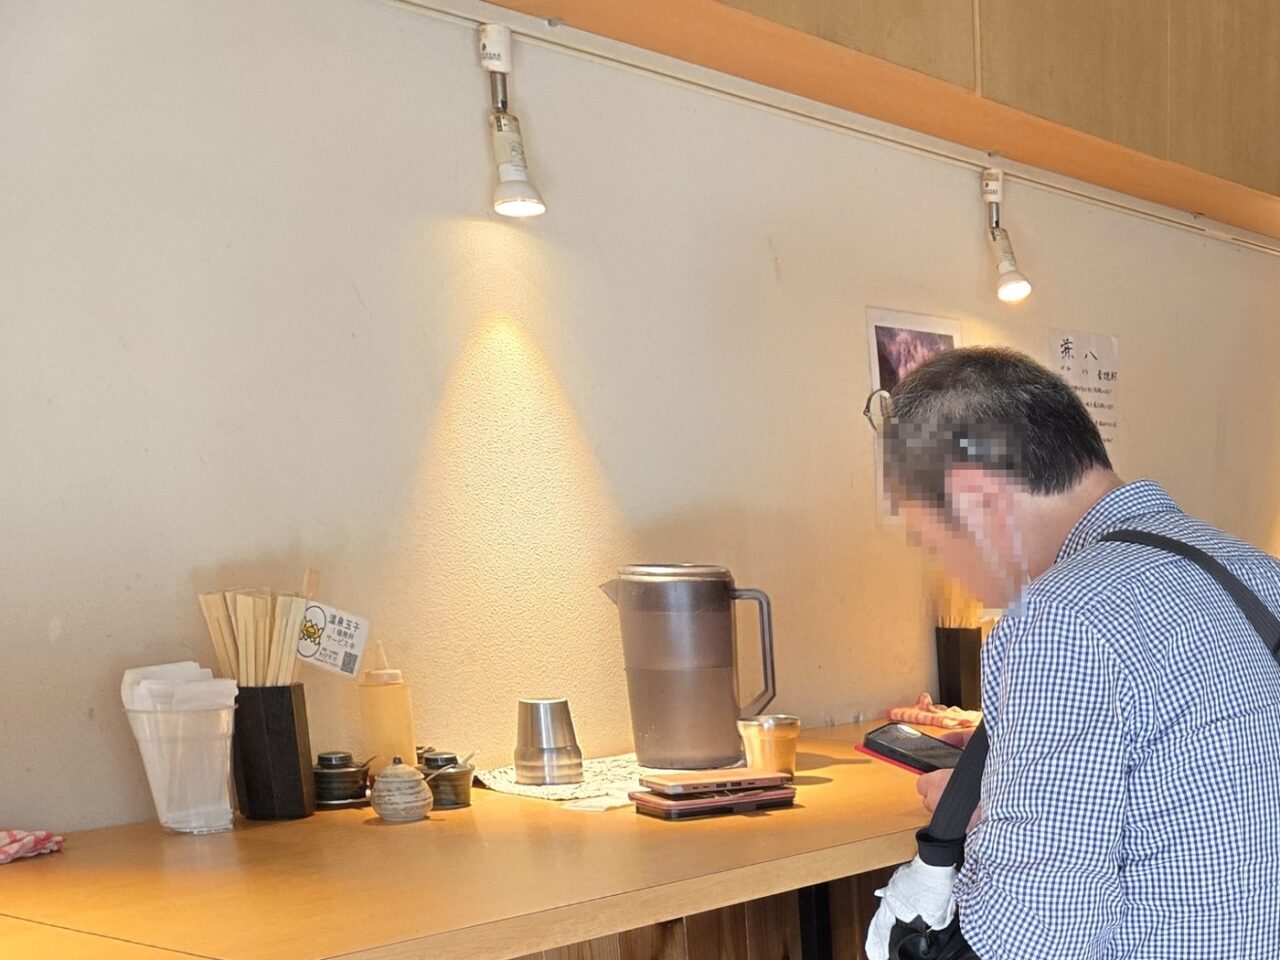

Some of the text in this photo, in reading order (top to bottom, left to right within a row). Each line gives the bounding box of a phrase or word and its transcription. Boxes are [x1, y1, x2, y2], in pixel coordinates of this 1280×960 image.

[328, 614, 360, 632] 温泉玉子
[326, 634, 355, 650] サービス中
